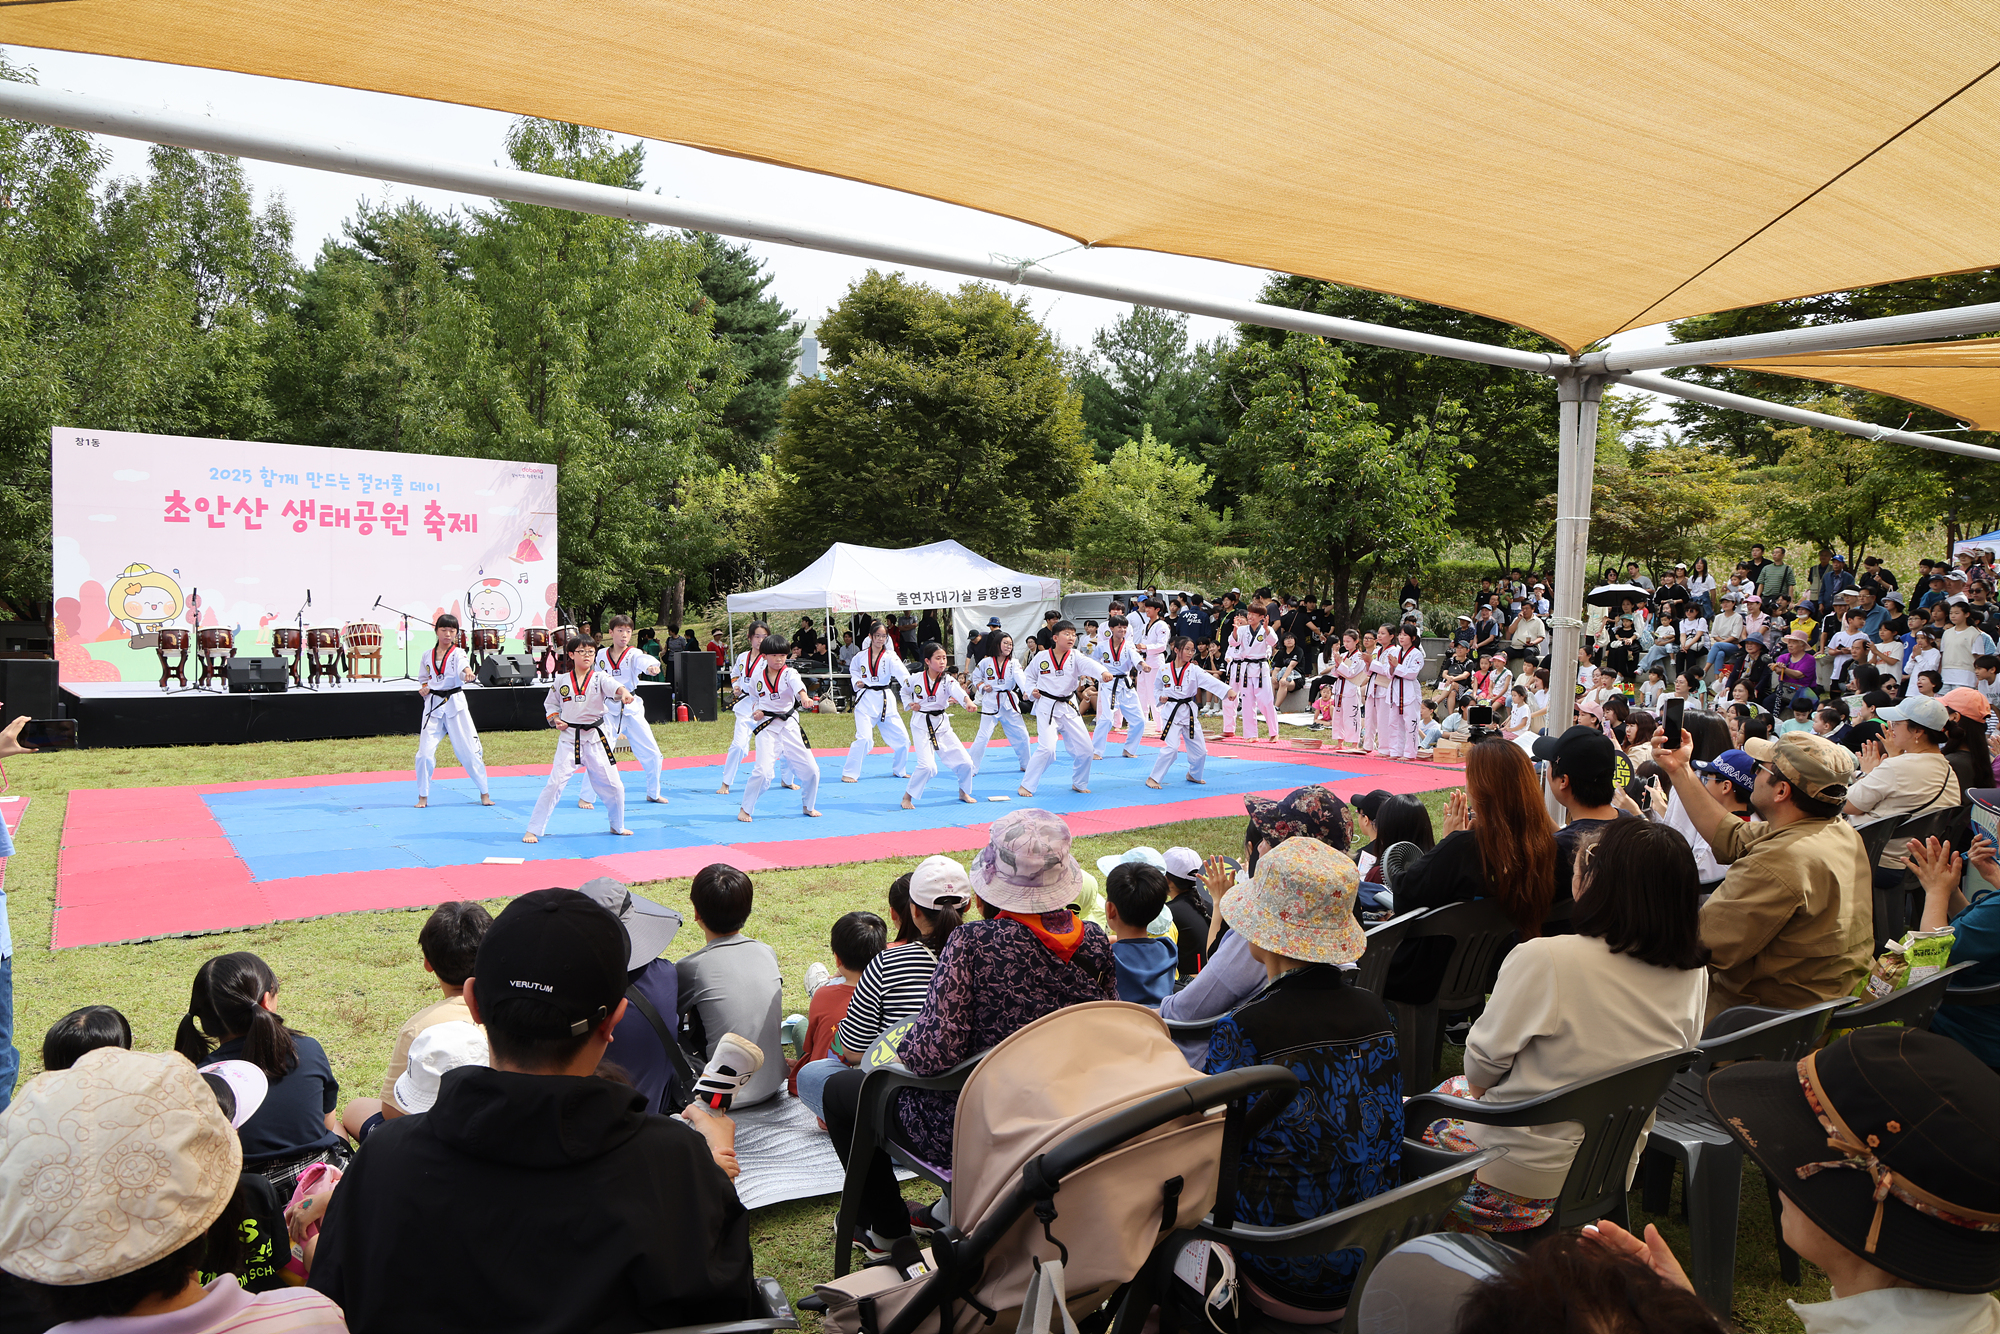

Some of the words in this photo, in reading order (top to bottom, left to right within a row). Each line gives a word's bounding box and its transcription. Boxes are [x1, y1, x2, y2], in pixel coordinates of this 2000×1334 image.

[75, 437, 100, 448] 창1동
[209, 467, 253, 484] 2025
[259, 466, 299, 488] 함께
[306, 472, 350, 491] 만드는
[357, 473, 404, 496] 컬러풀
[409, 481, 440, 493] 데이
[164, 489, 269, 530] 초안산
[281, 499, 409, 536] 생태공원
[423, 500, 478, 542] 축제
[896, 590, 973, 606] 출연자대기실
[976, 585, 1023, 601] 음향운영
[509, 980, 554, 993] VERUTUM
[249, 1265, 275, 1280] SCH
